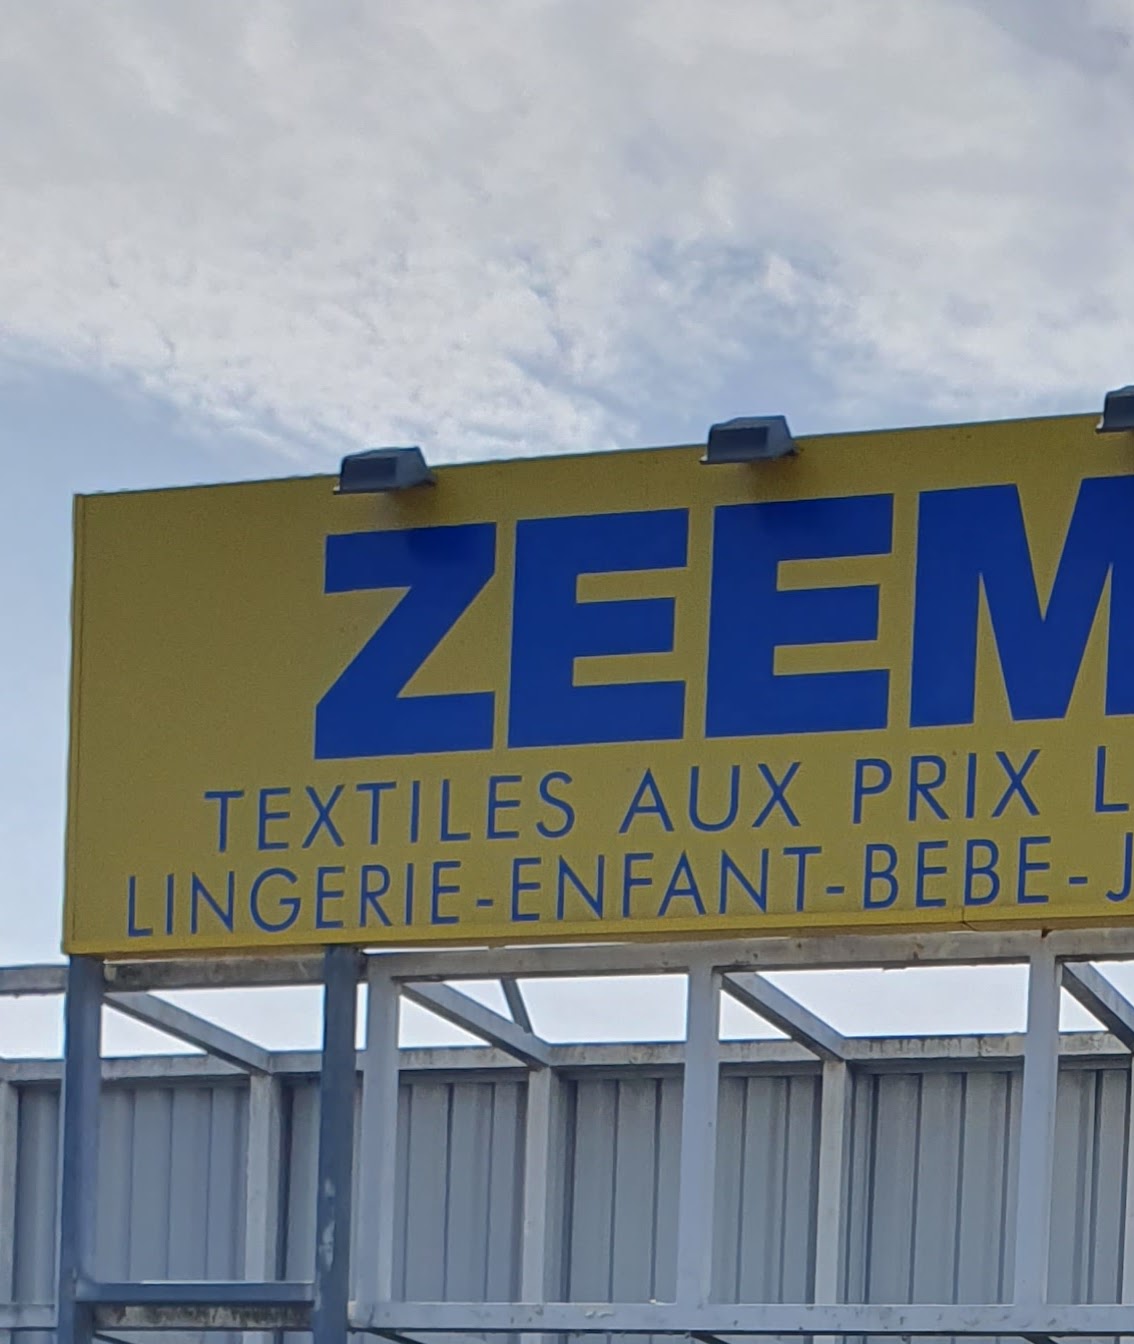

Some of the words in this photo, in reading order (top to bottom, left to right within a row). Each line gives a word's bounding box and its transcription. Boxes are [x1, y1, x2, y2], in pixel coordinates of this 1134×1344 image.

[205, 771, 575, 852] TEXTILES
[619, 763, 800, 833] AUX
[852, 751, 1039, 824] PRIX
